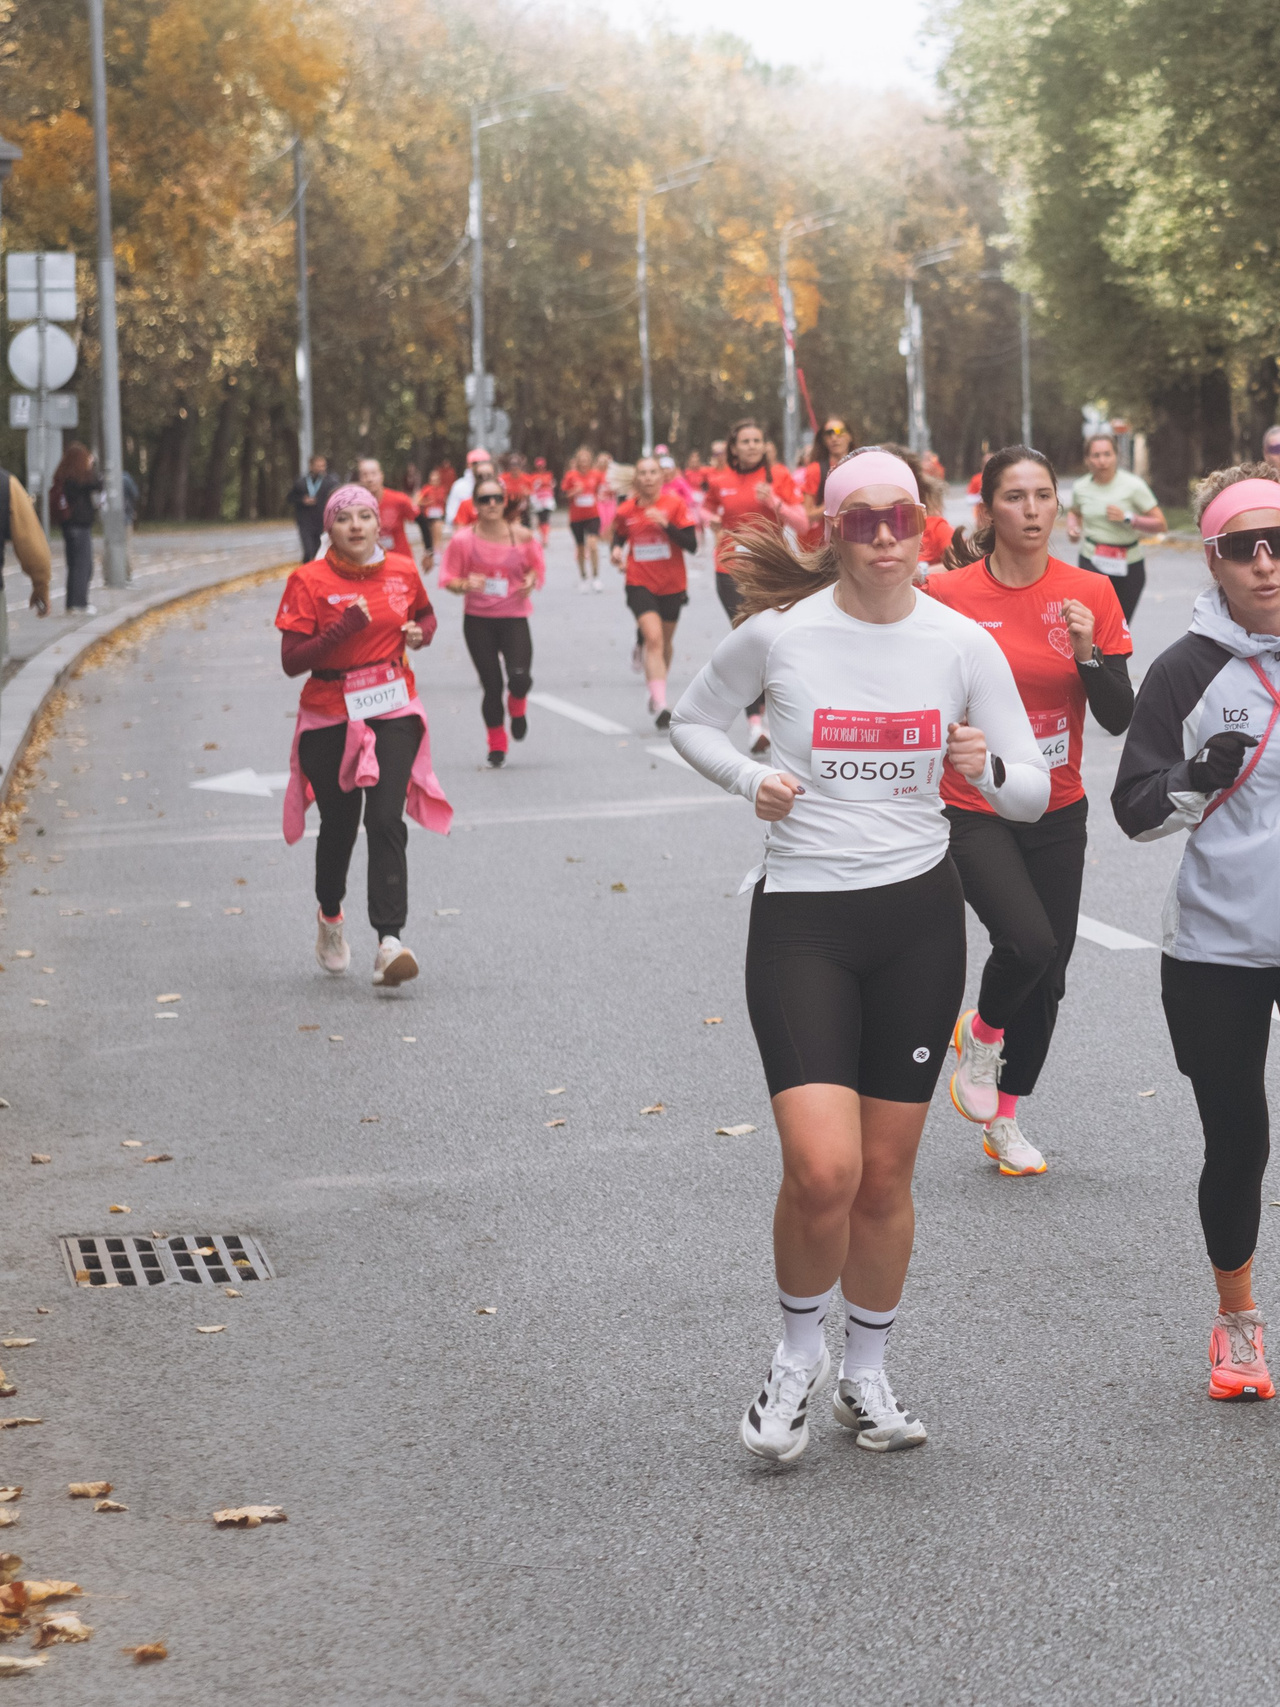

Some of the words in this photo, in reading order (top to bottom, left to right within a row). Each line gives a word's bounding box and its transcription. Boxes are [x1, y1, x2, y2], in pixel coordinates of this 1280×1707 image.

[352, 688, 396, 710] 30017
[1222, 707, 1249, 723] tcs
[1224, 722, 1250, 731] SYDNEY
[821, 727, 858, 743] РОЗОВЫЙ
[859, 728, 881, 743] ЗАБЕГ
[1042, 740, 1065, 757] 46
[820, 760, 915, 781] 30505
[893, 788, 899, 796] 3
